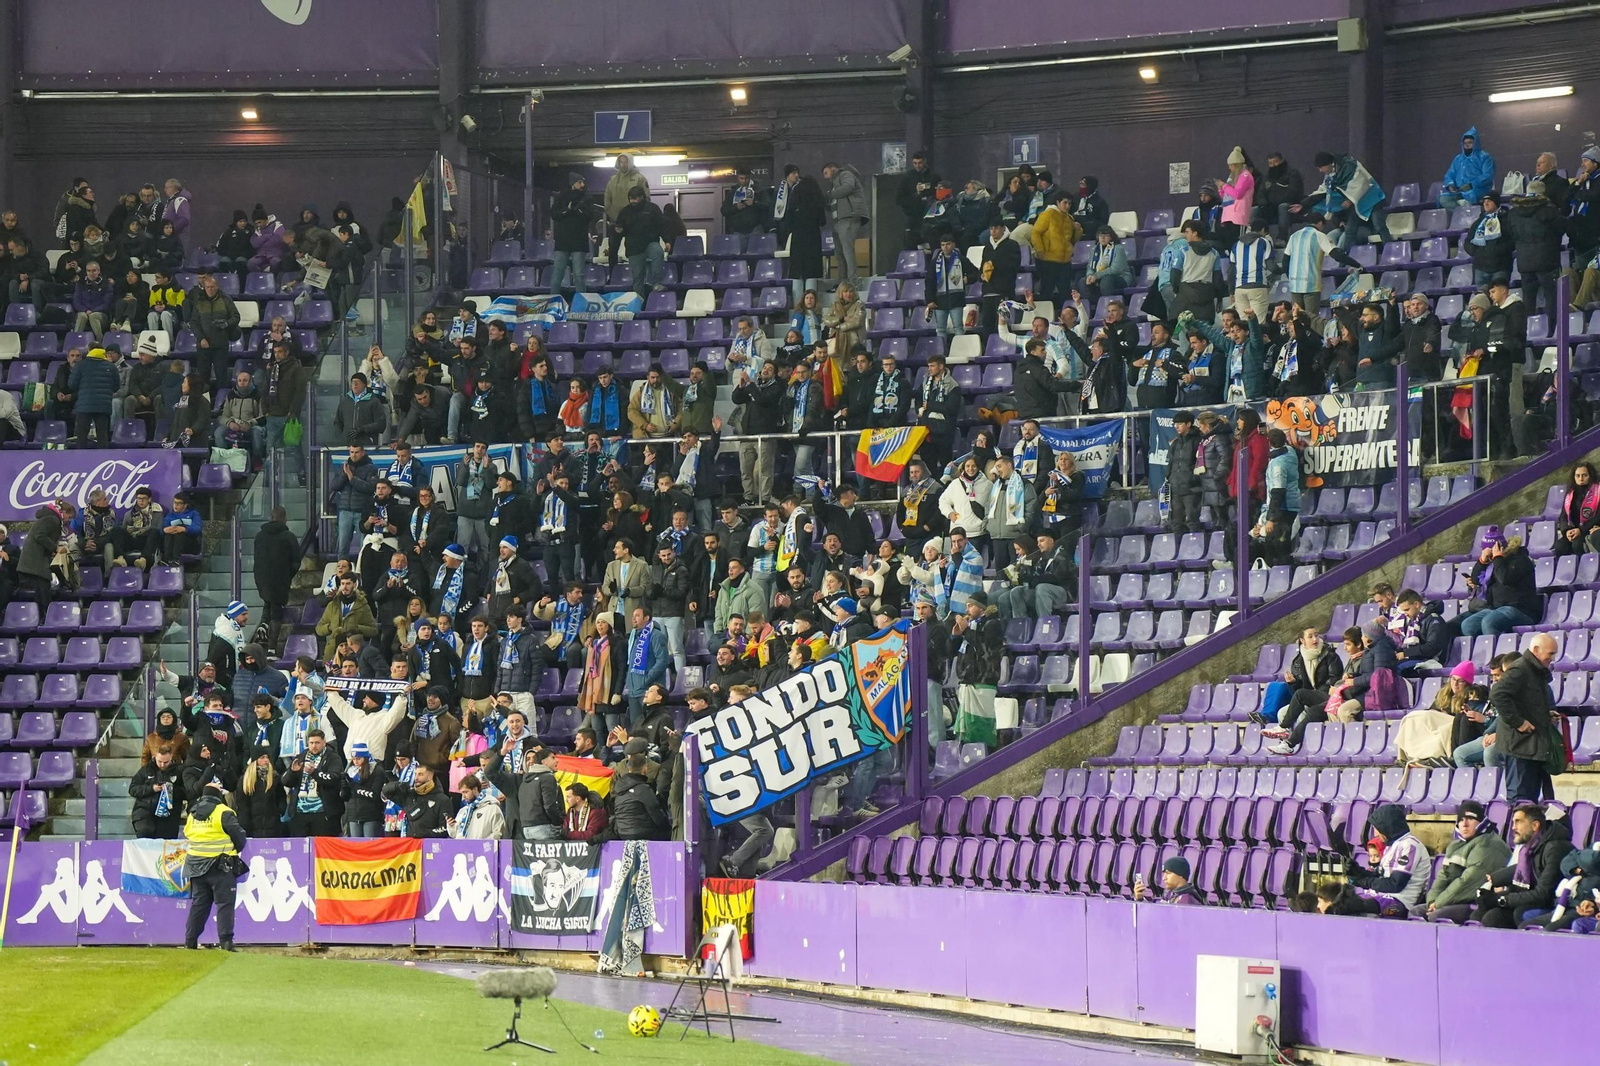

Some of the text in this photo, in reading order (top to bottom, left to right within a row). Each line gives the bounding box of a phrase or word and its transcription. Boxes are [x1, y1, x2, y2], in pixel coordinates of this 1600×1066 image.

[616, 114, 629, 140] 7
[663, 175, 688, 184] SALIDA
[1338, 404, 1391, 433] FRENTE
[9, 460, 158, 510] Coca-Cola
[348, 680, 360, 690] DE
[360, 682, 371, 691] LA
[687, 660, 849, 763] FONDO
[703, 704, 861, 816] SUR
[523, 840, 589, 858] EL FARY VIVE
[320, 861, 418, 891] GUADALMAR
[520, 914, 590, 931] LA LUCHA SIGUE
